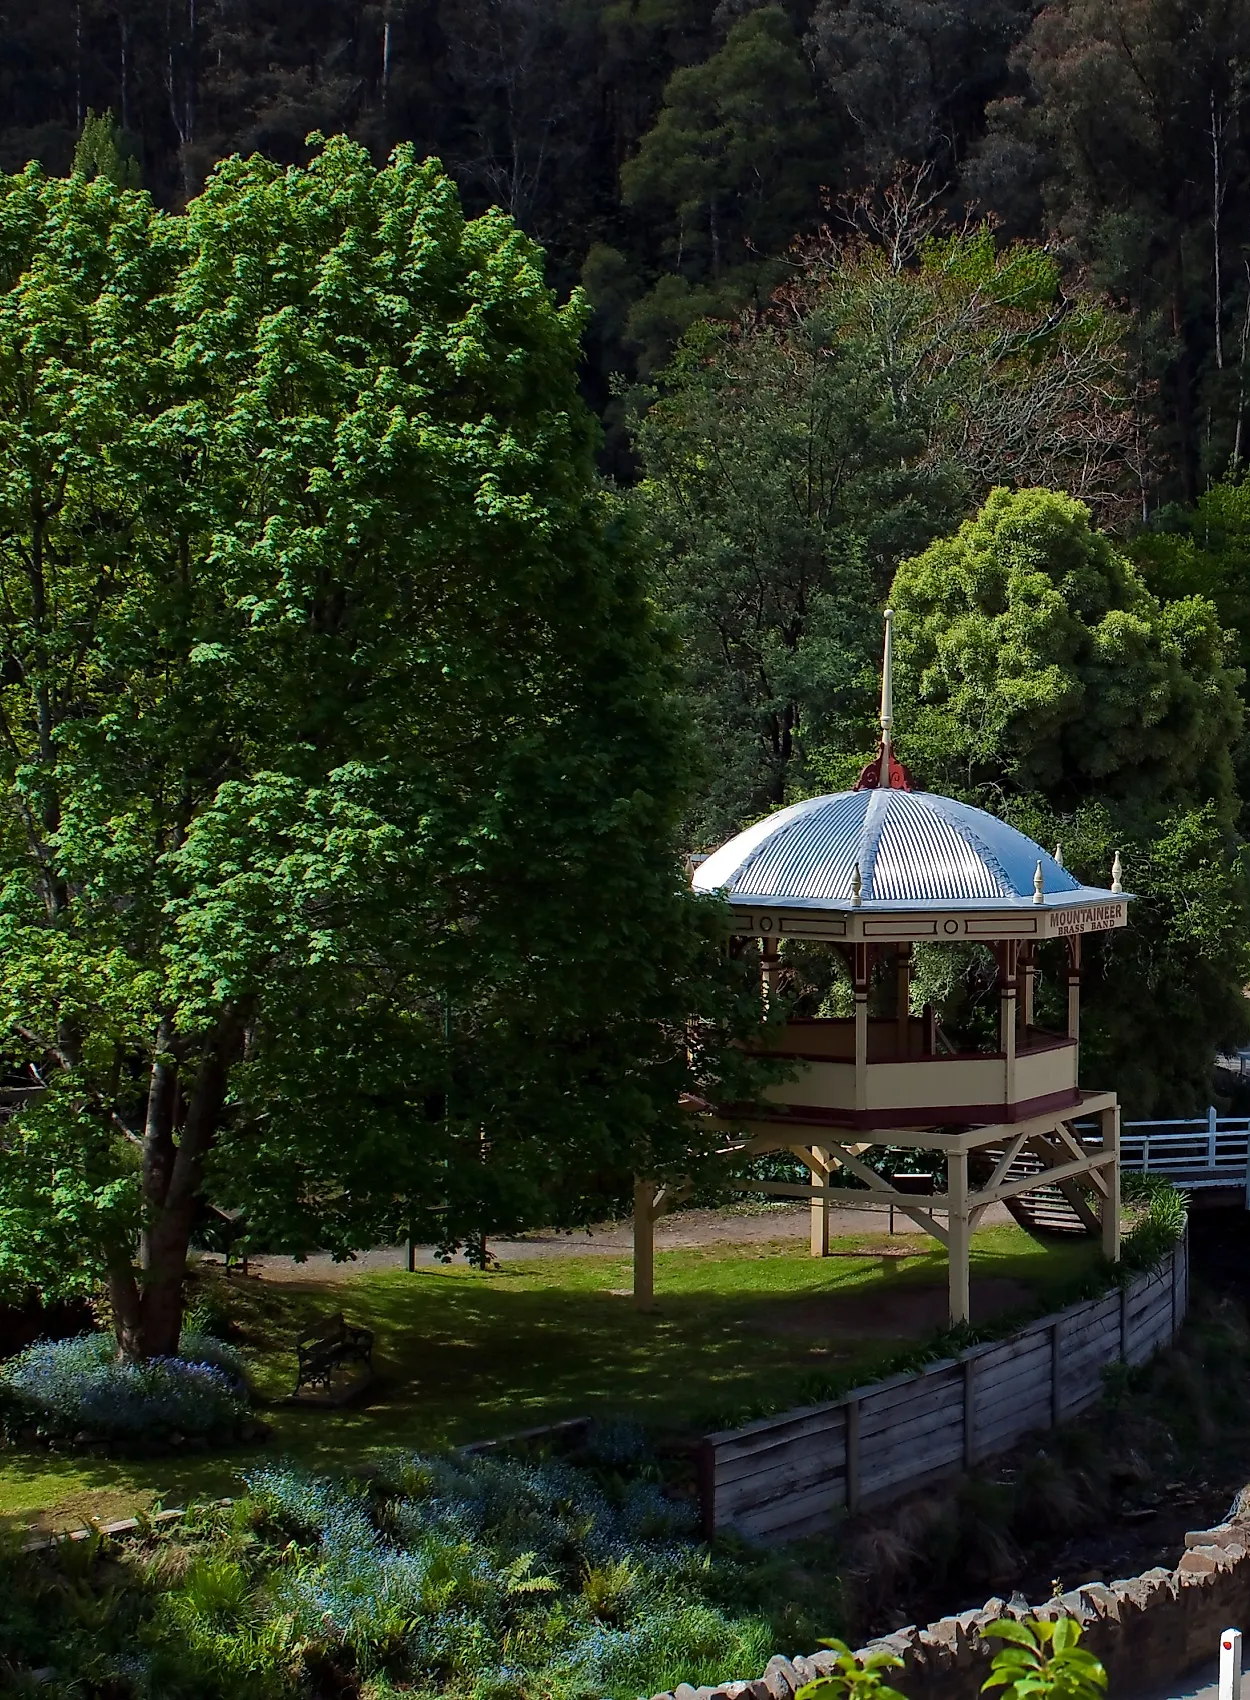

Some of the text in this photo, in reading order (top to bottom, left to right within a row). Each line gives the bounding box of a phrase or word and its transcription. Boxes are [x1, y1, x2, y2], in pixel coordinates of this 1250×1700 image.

[1050, 904, 1122, 928] MOUNTAINEER
[1058, 919, 1115, 936] BRASS BAND
